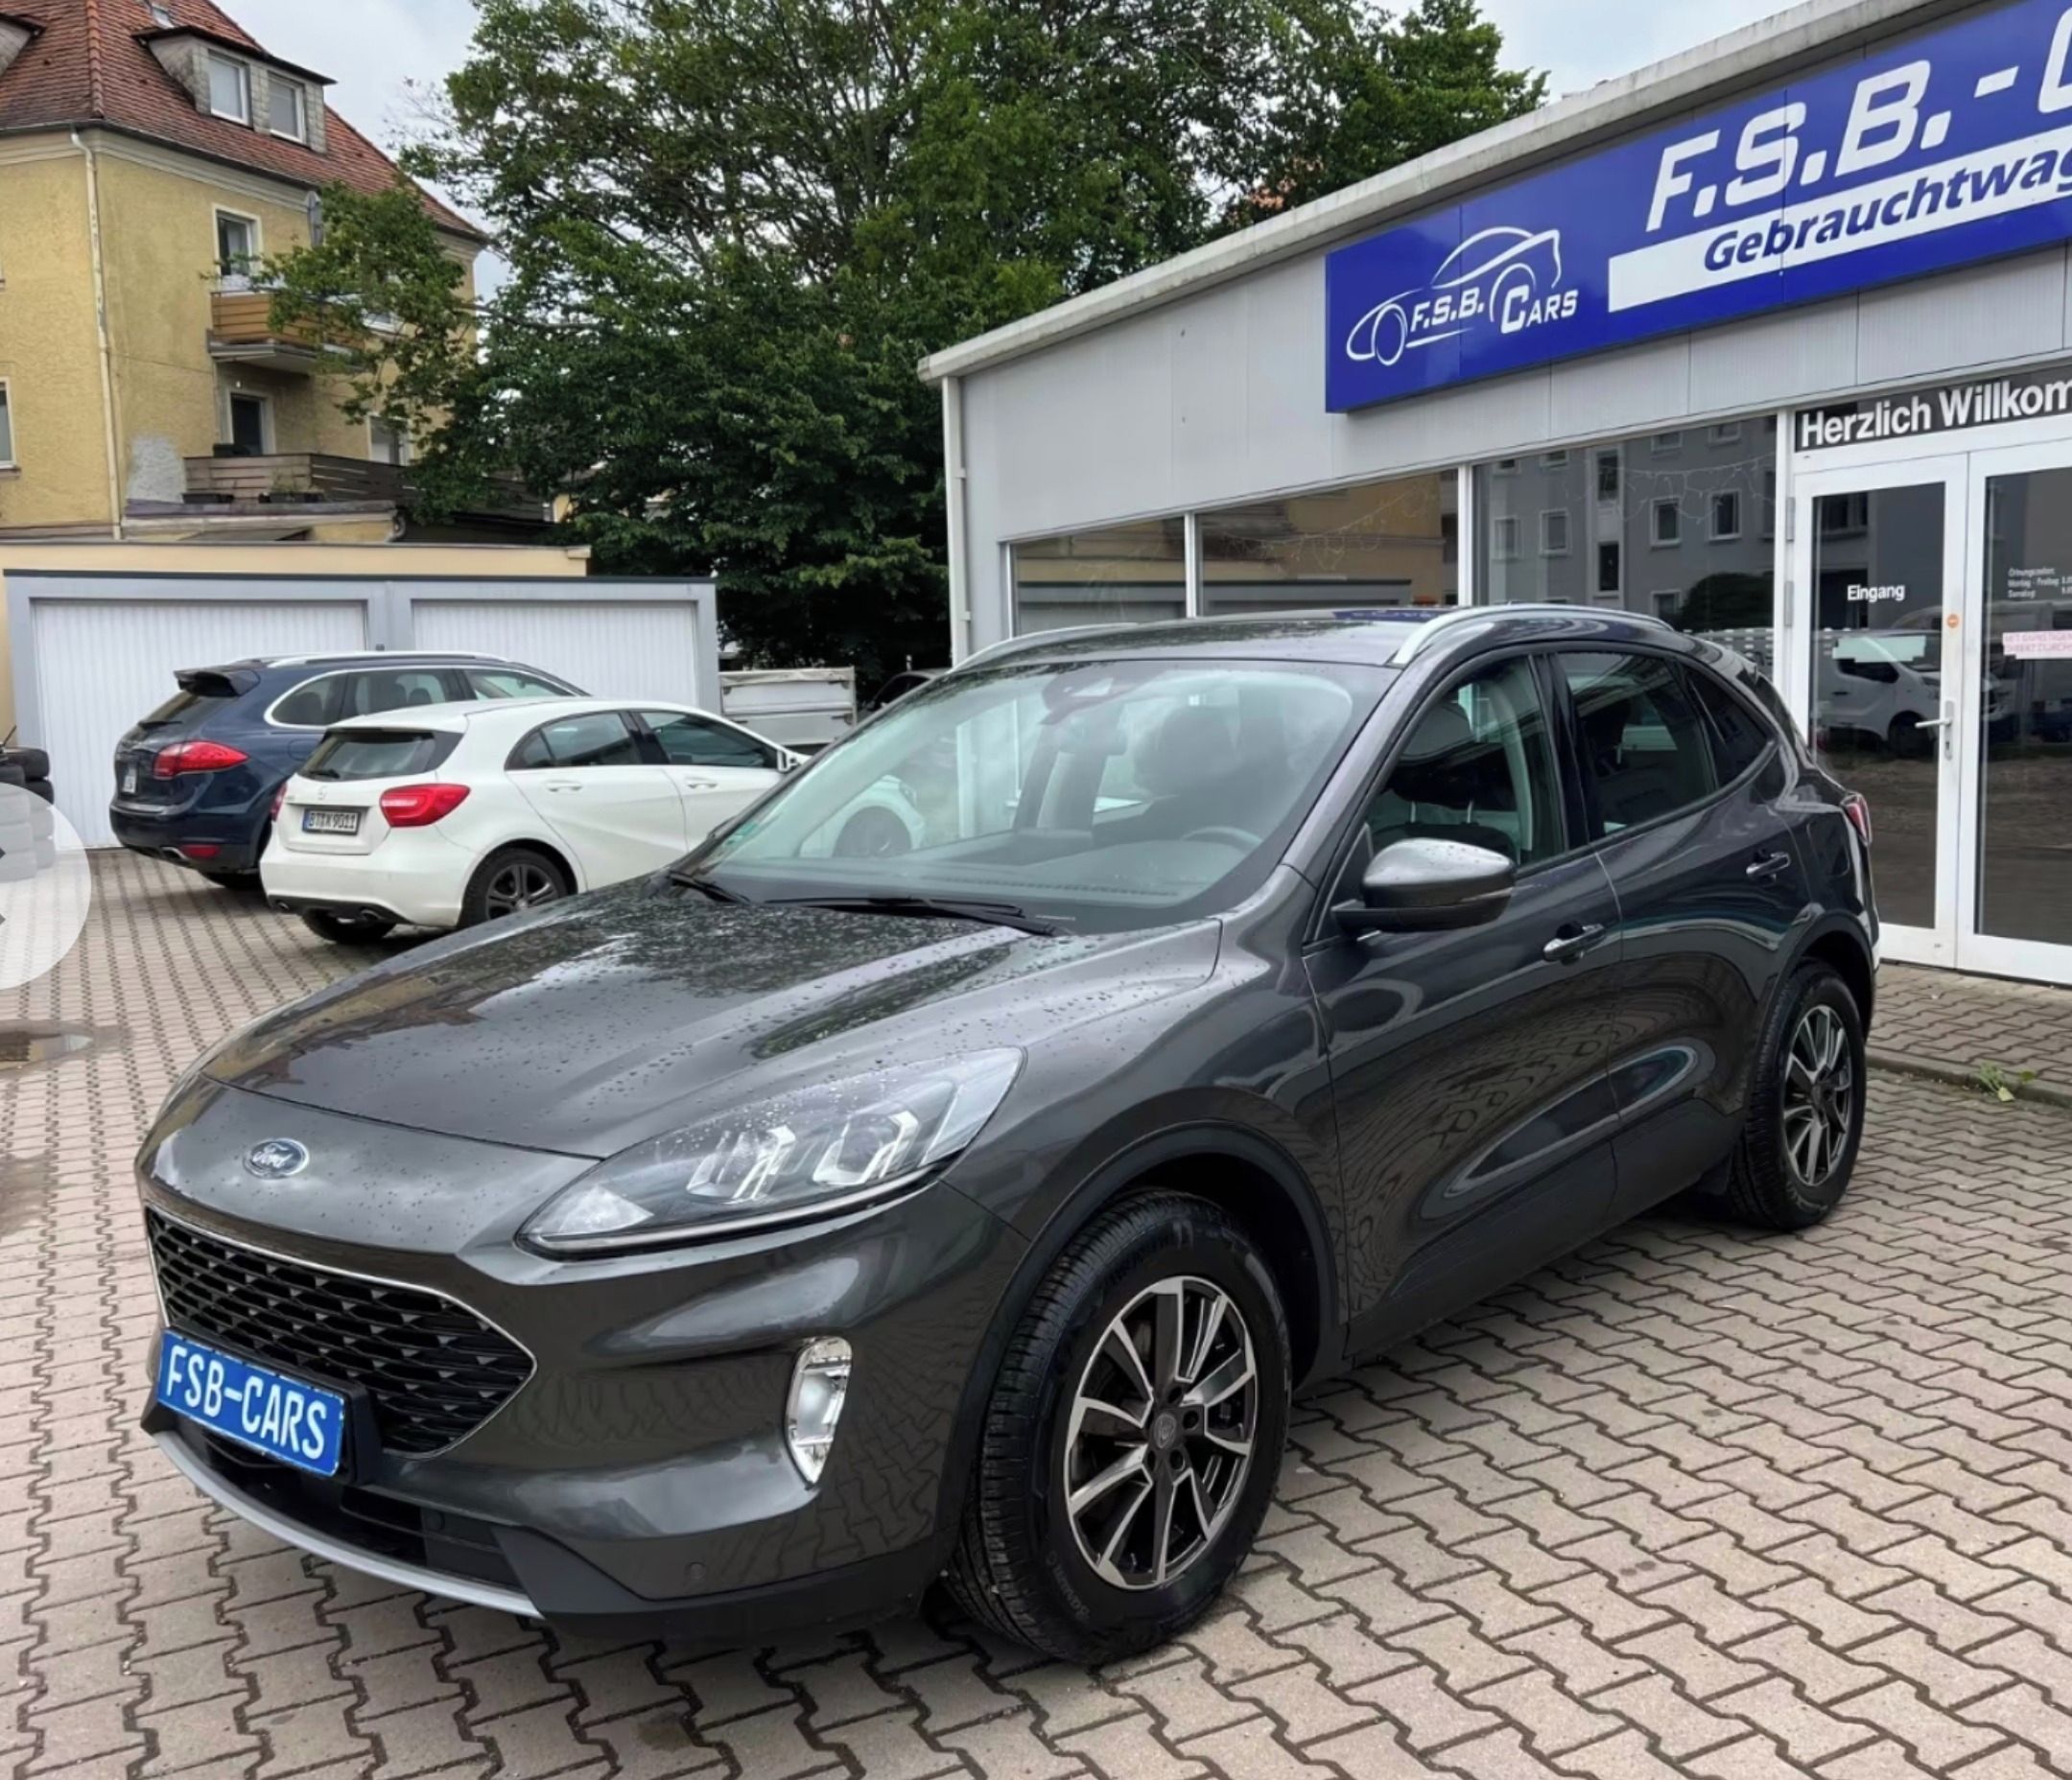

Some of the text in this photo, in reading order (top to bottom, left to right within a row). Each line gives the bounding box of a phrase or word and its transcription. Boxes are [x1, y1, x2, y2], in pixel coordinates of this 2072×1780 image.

[1646, 59, 1951, 232] F.S.B.
[1410, 287, 1485, 332] F.S.B.
[1801, 396, 1931, 447] Herzlich
[1847, 584, 1905, 602] Eingang
[167, 1346, 327, 1459] FSB-CARS
